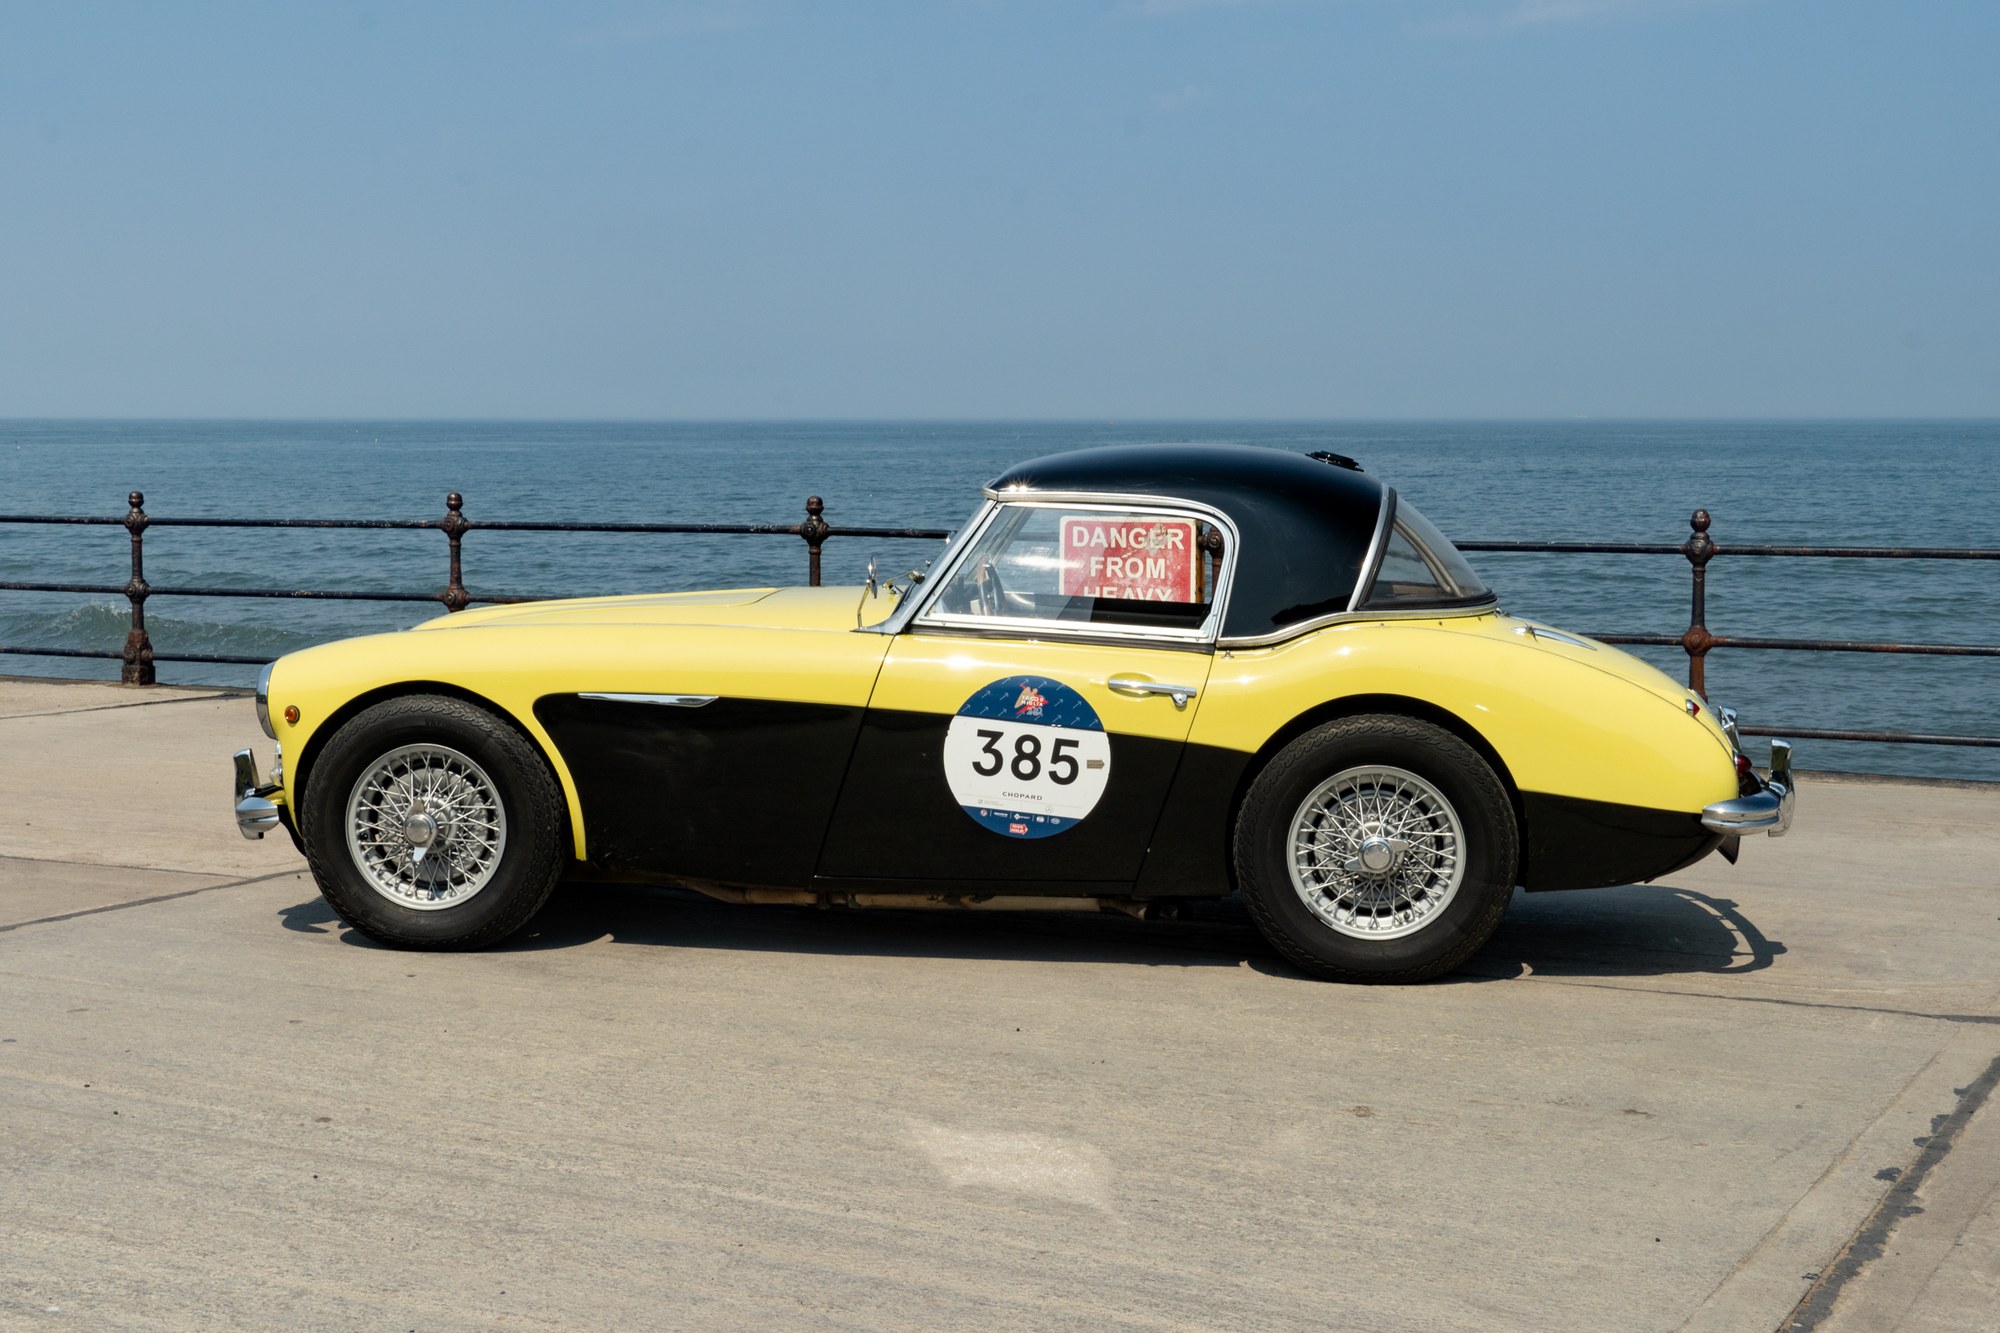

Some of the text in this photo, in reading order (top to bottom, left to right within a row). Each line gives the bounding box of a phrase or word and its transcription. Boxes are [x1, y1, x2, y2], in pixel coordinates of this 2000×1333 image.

[1072, 526, 1184, 550] DANGER
[1090, 556, 1166, 579] FROM
[972, 729, 1080, 786] 385
[1002, 791, 1043, 801] CHOPARD
